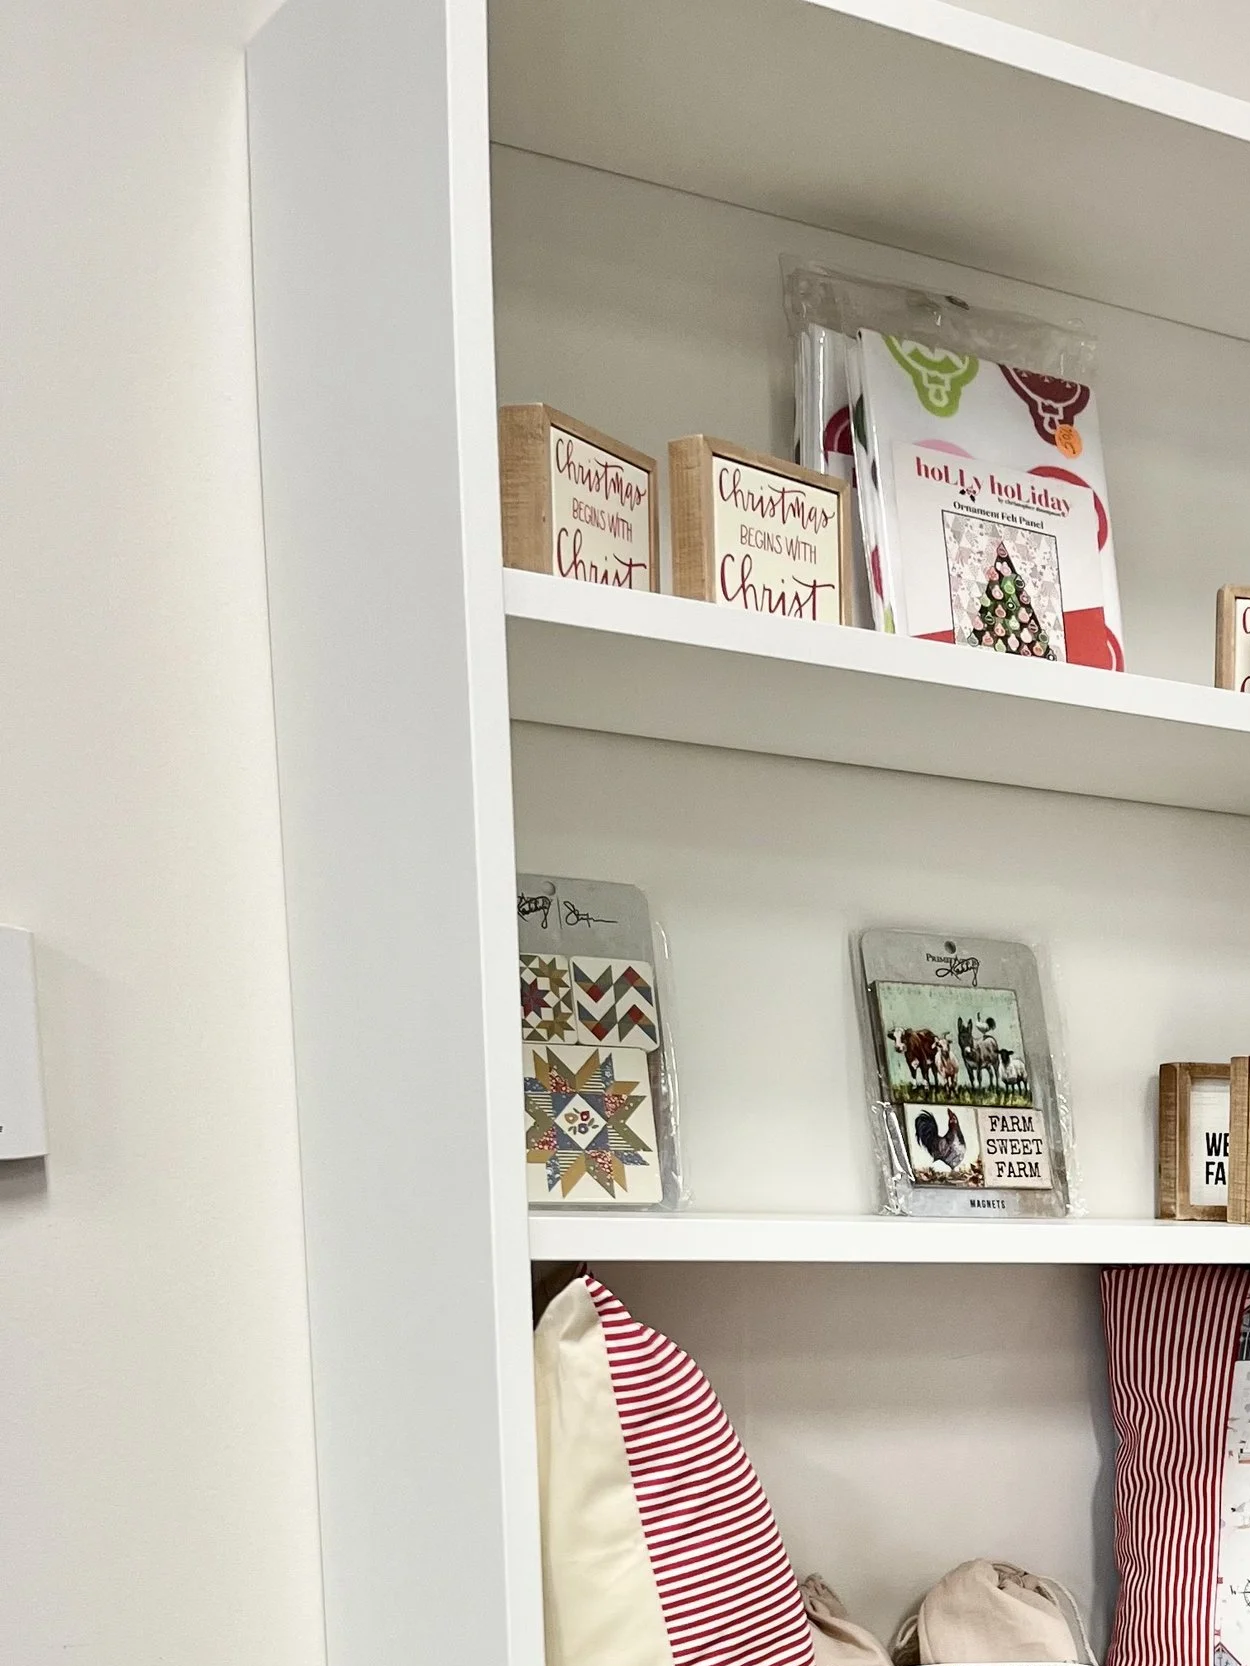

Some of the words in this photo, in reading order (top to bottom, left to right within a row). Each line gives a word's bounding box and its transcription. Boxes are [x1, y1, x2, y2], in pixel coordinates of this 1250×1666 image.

[555, 438, 647, 512] Christmas
[572, 497, 606, 530] BEGINS
[607, 514, 633, 543] WITH
[719, 467, 836, 534] Christmas
[953, 500, 1000, 520] Ornament
[1001, 511, 1018, 524] Felt
[1019, 516, 1045, 530] Panel
[556, 527, 647, 590] Christ
[740, 524, 783, 556] BEGINS
[784, 536, 818, 565] WITH
[720, 553, 836, 621] Christ
[988, 1115, 1035, 1132] FARM
[986, 1138, 1043, 1155] SWEET
[995, 1161, 1042, 1178] FARM
[969, 1199, 1006, 1209] MAGNETS
